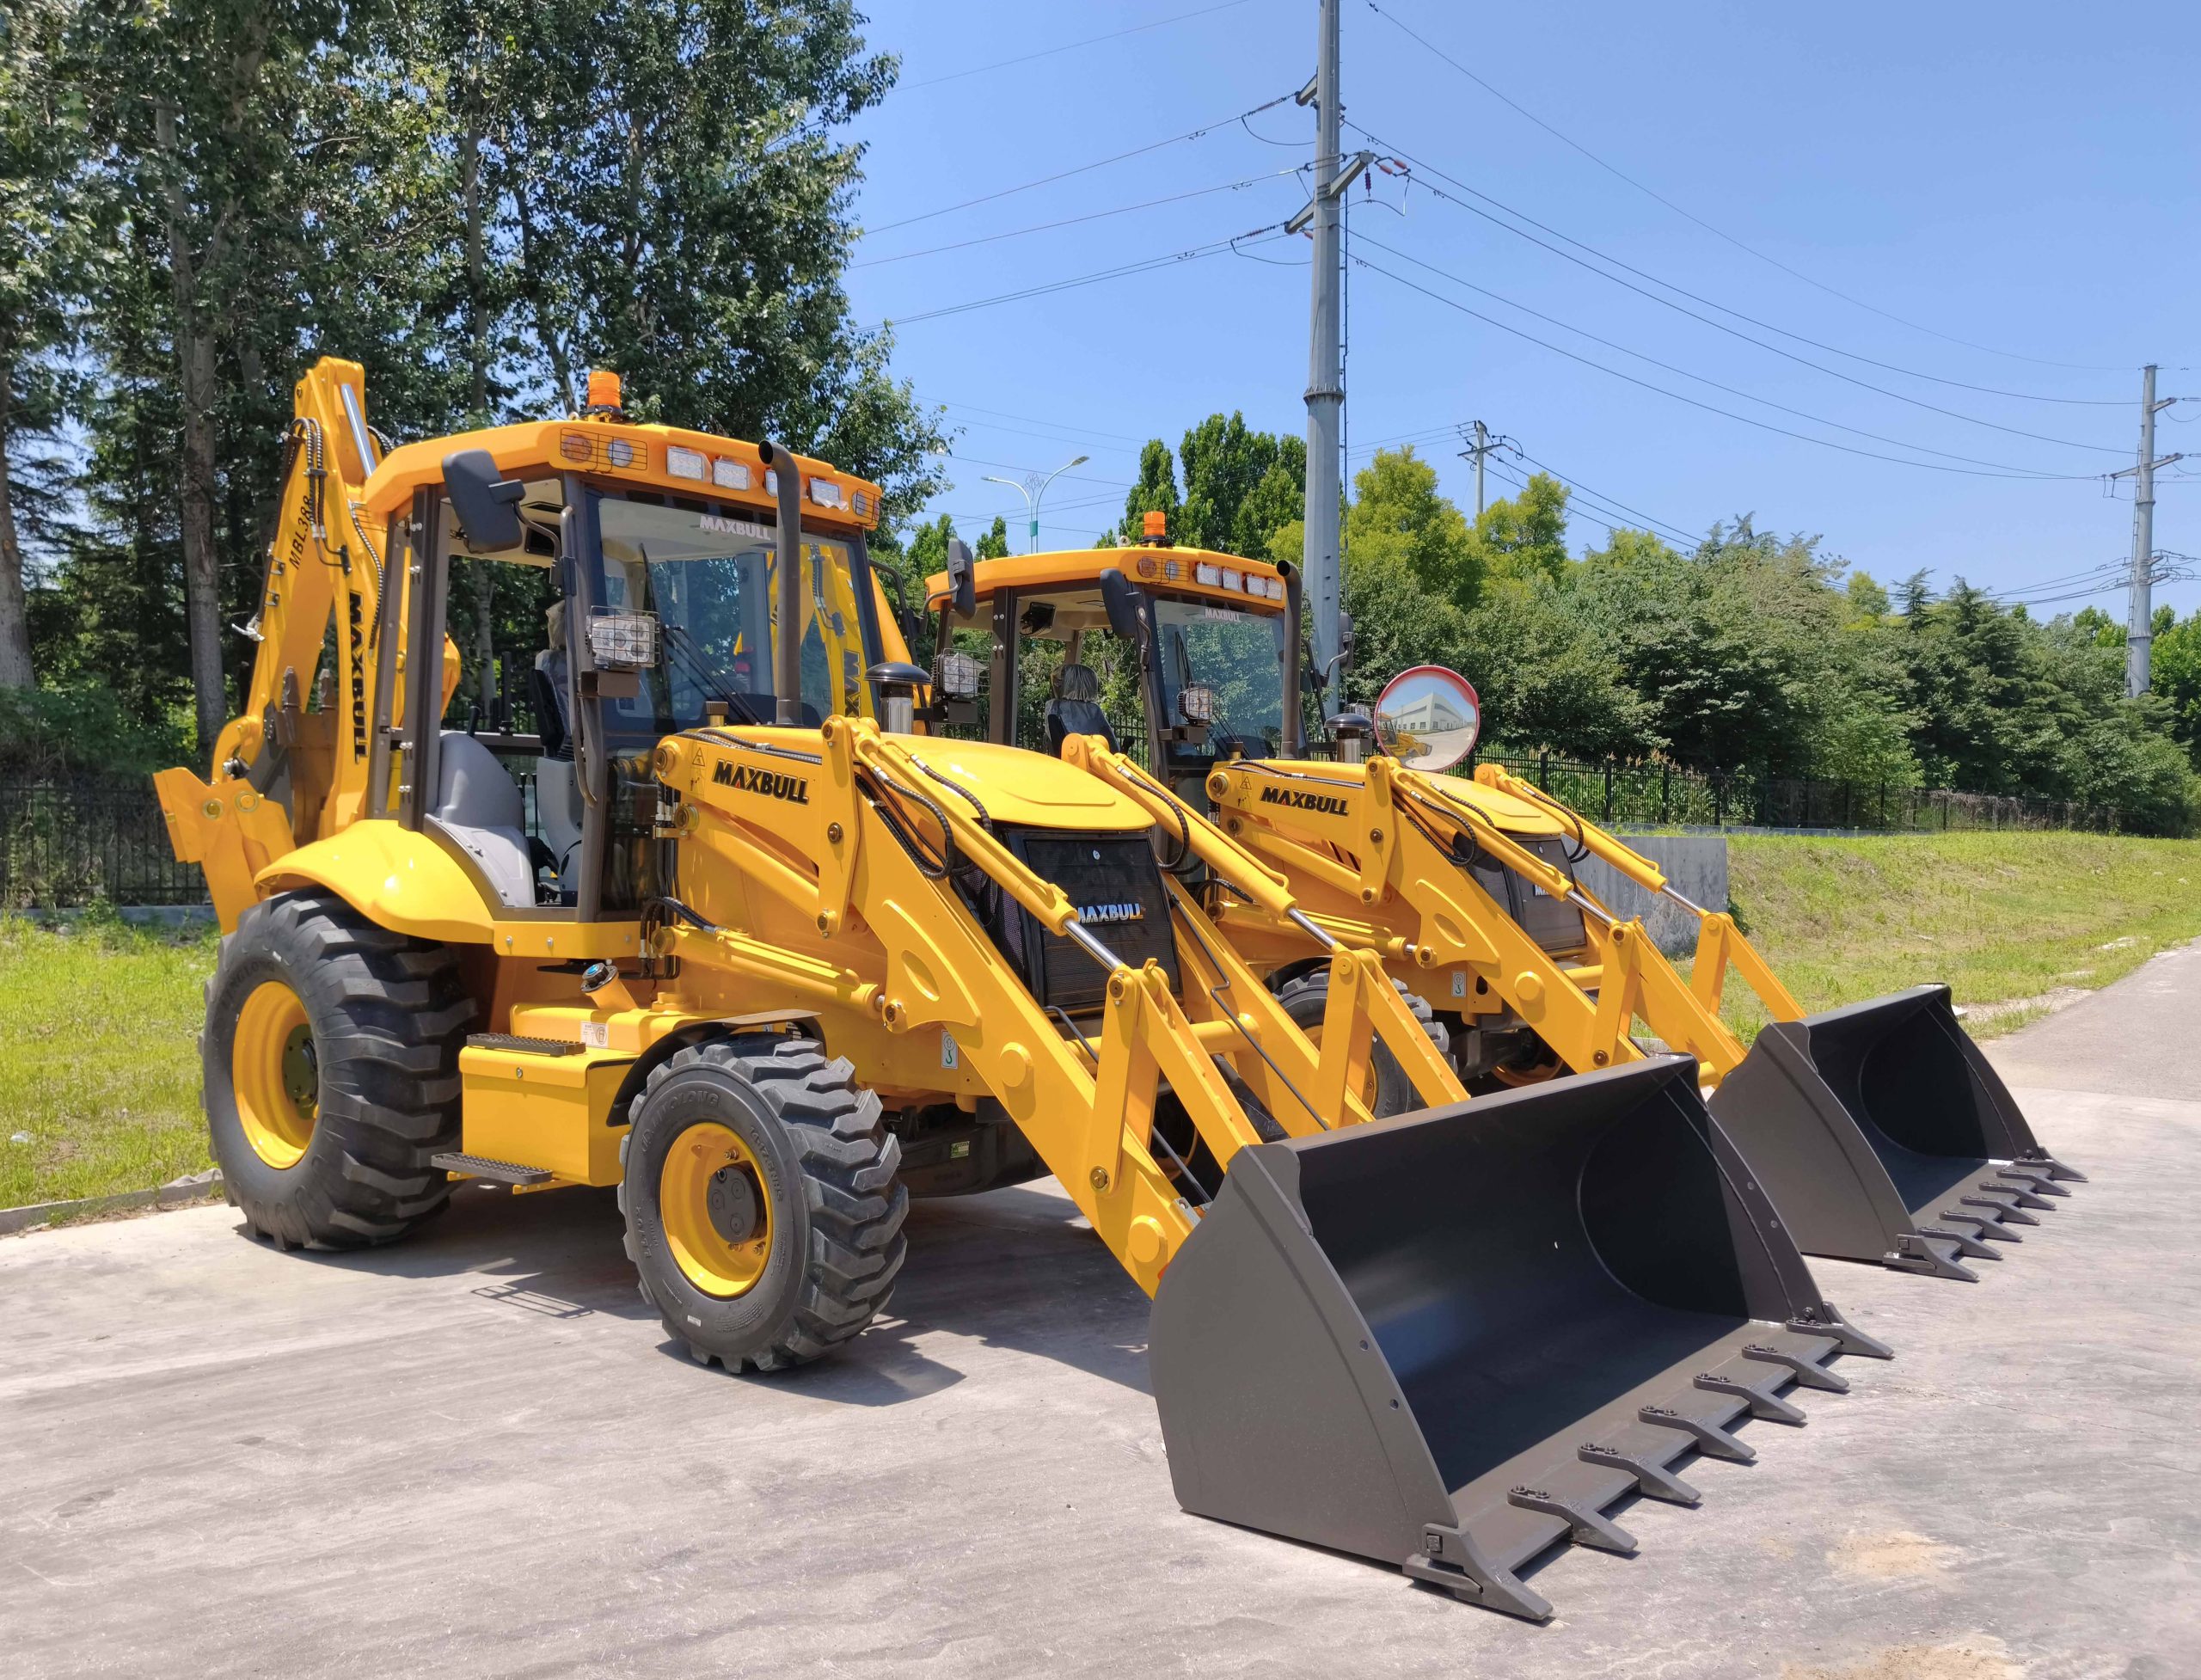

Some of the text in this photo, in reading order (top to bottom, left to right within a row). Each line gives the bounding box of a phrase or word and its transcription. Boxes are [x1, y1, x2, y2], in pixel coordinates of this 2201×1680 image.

[699, 515, 771, 541] MAXBULL
[1205, 608, 1242, 623] MAXBULL
[349, 590, 369, 765] MAXBULL
[712, 757, 810, 806] MAXBULL
[1260, 784, 1350, 818] MAXBULL
